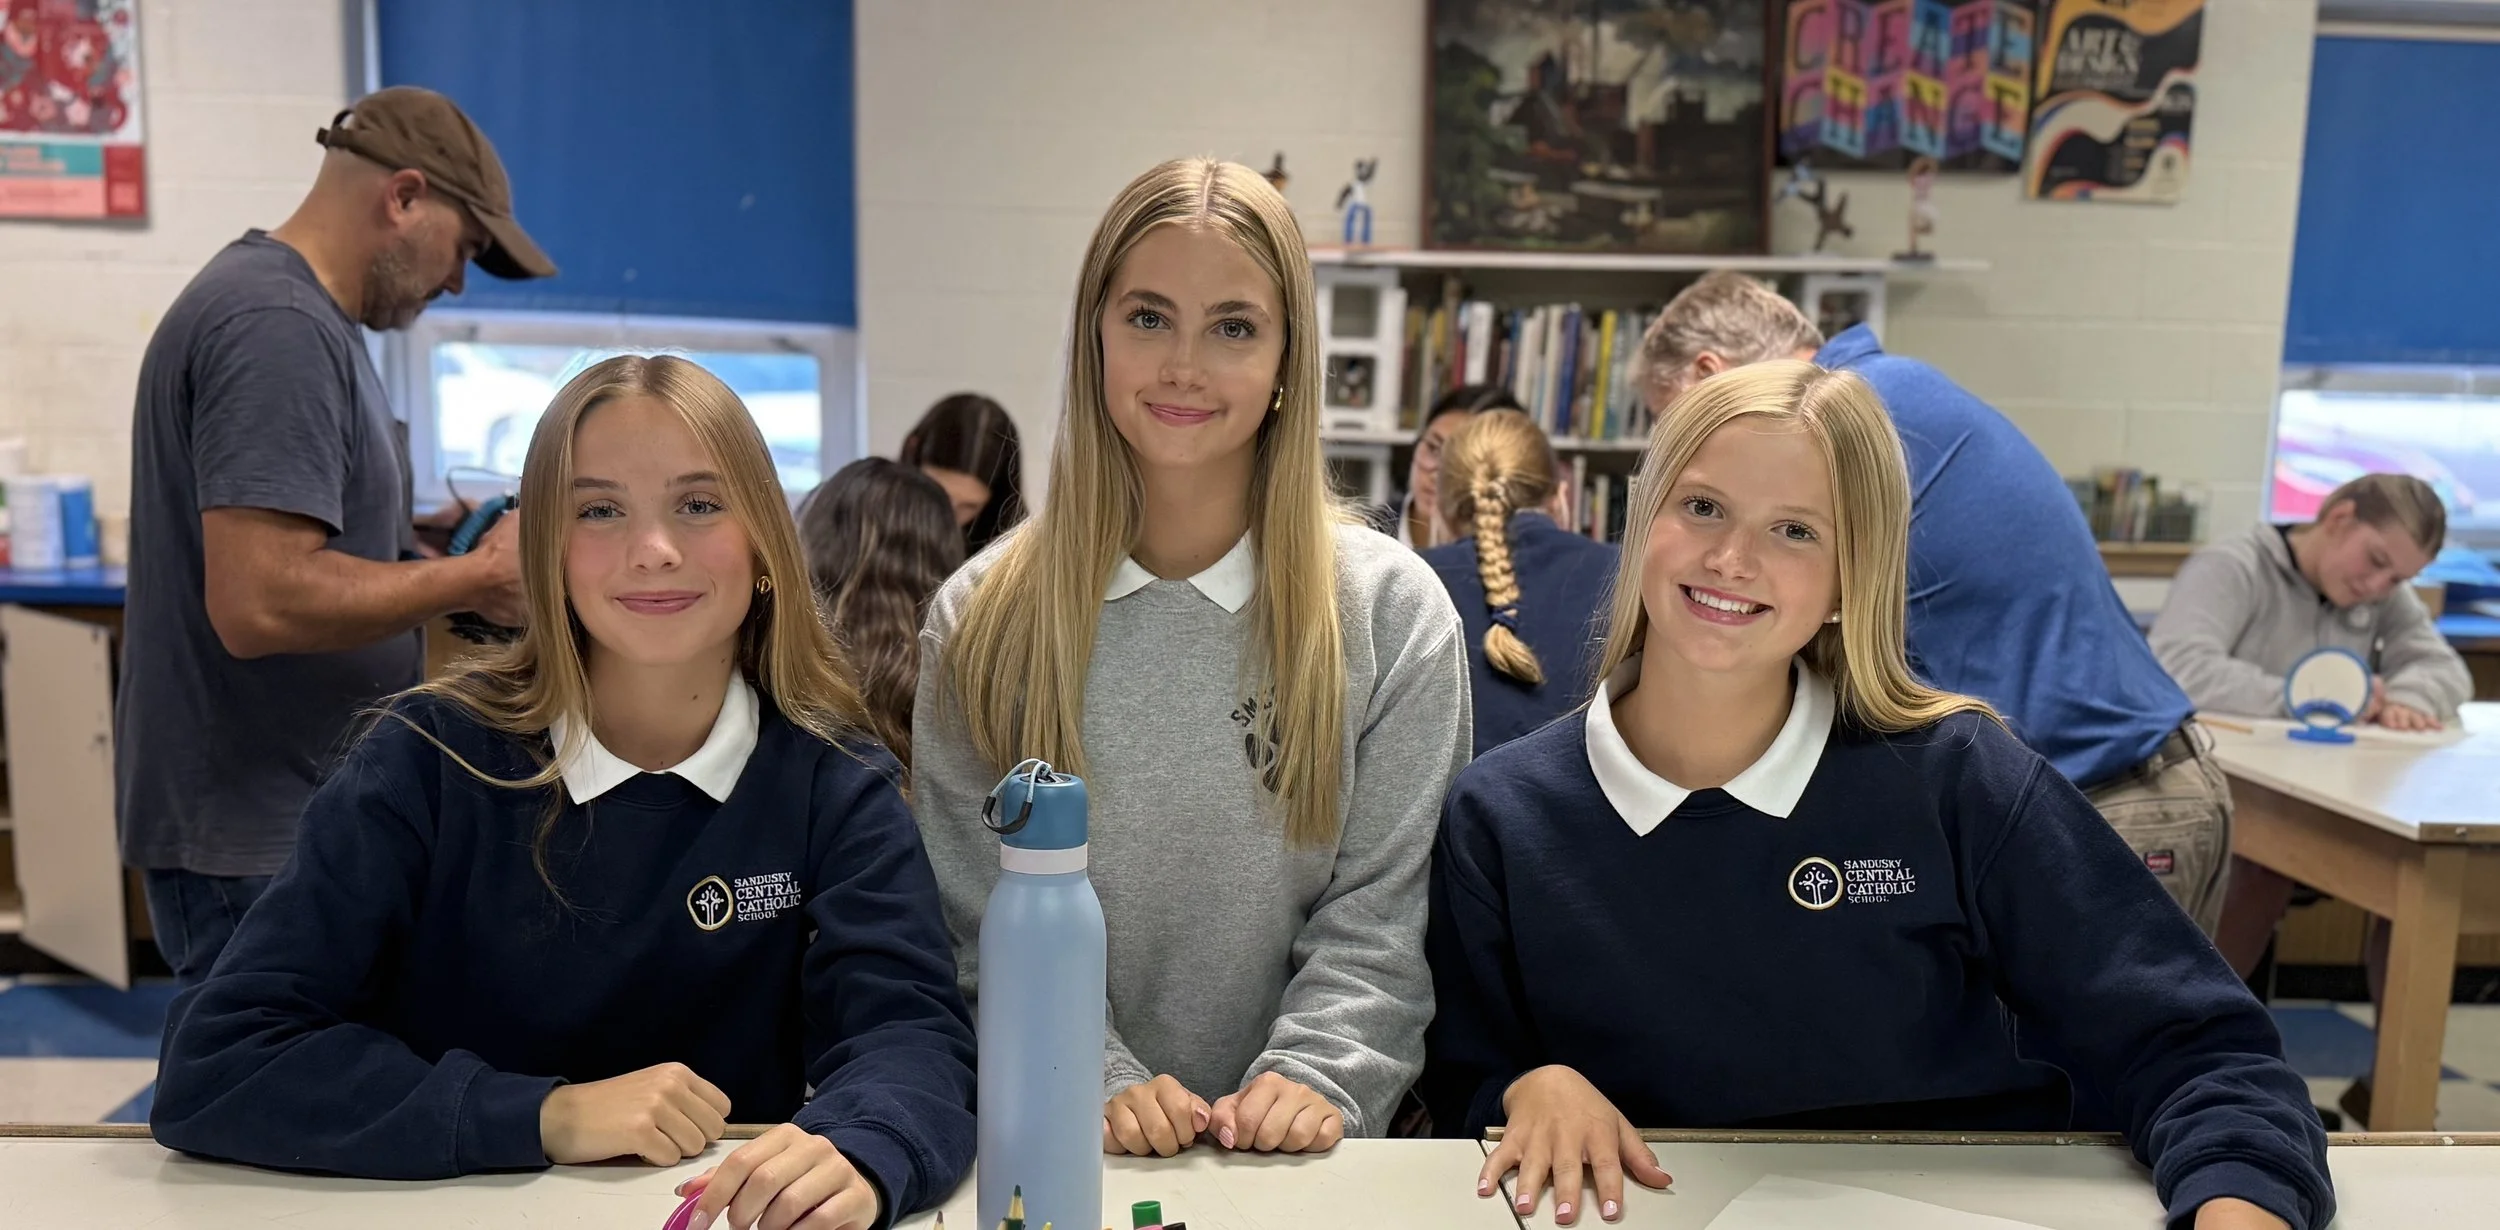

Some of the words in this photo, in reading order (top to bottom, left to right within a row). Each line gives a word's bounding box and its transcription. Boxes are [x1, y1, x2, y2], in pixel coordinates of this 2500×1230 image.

[1793, 2, 2027, 80] CREATE
[1788, 74, 2023, 156] CHANGE
[1843, 858, 1902, 870] SANDUSKY
[734, 871, 793, 888] SANDUSKY
[1845, 867, 1915, 883] CENTRAL
[735, 880, 801, 900] CENTRAL
[1846, 880, 1916, 896] CATHOLIC
[736, 893, 801, 914] CATHOLIC
[1848, 895, 1889, 904] SCHOOL
[737, 910, 778, 922] SCHOOL
